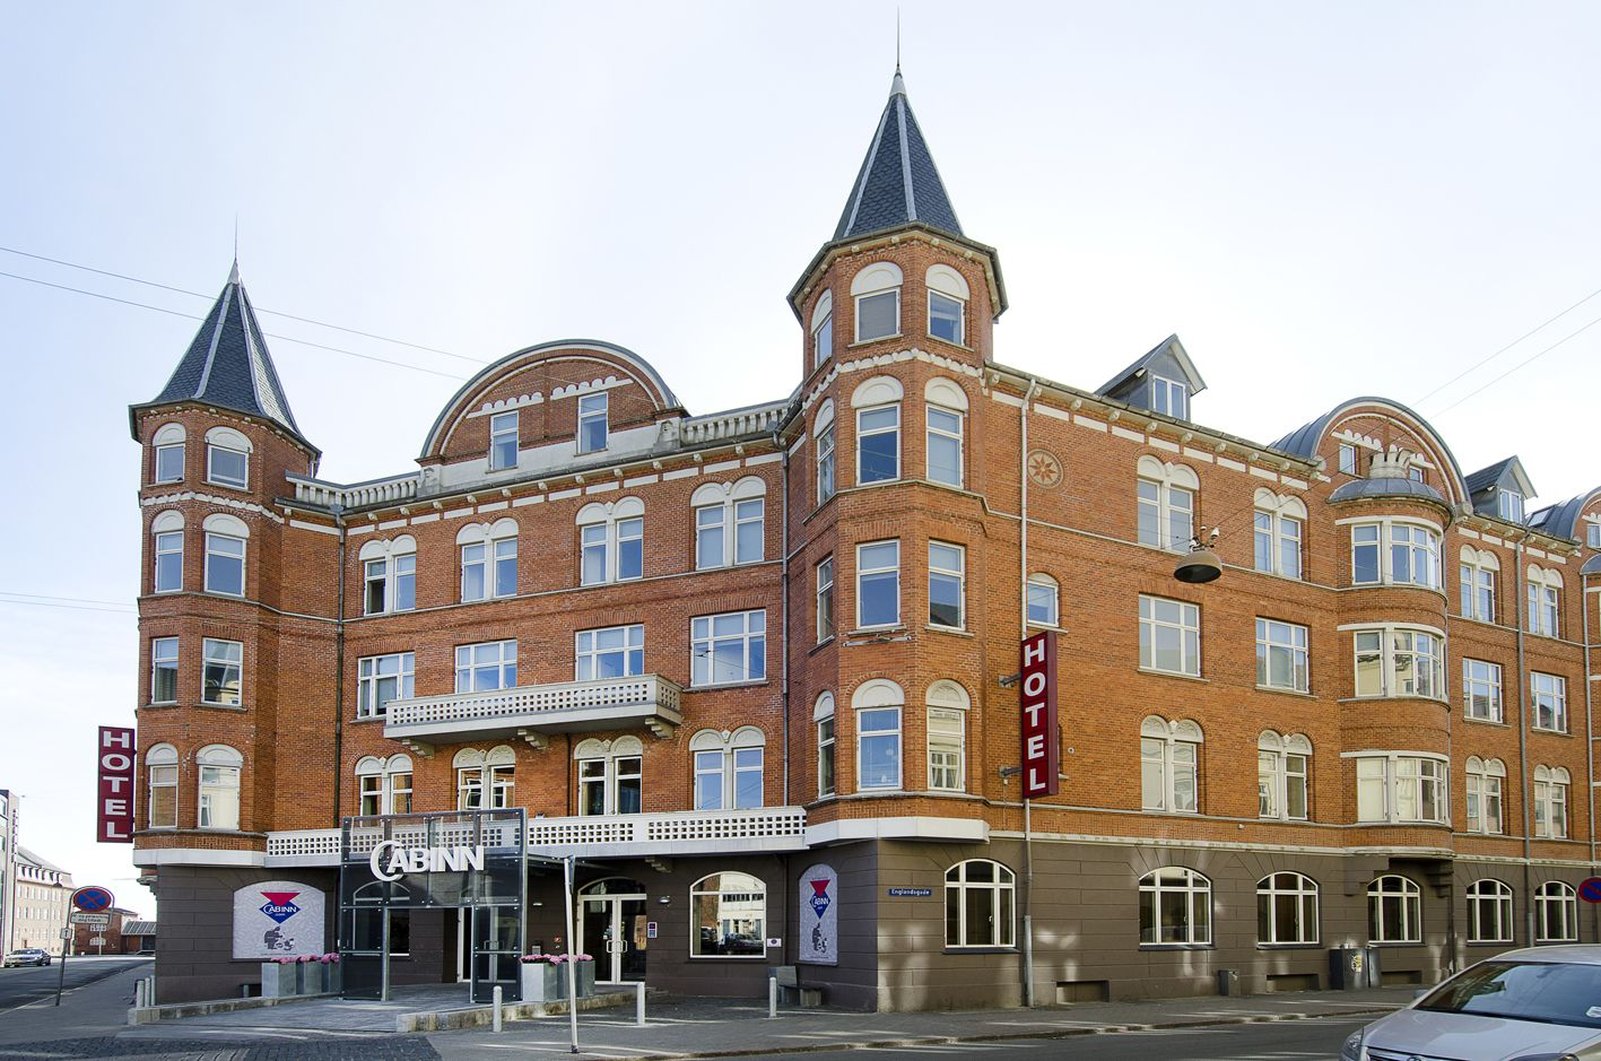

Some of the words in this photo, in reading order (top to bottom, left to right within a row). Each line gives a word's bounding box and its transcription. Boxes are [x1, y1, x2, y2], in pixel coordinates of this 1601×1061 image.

[1023, 639, 1046, 791] HOTEL
[101, 731, 131, 839] HOTEL
[370, 840, 485, 882] CABINN
[263, 904, 297, 915] CABINN
